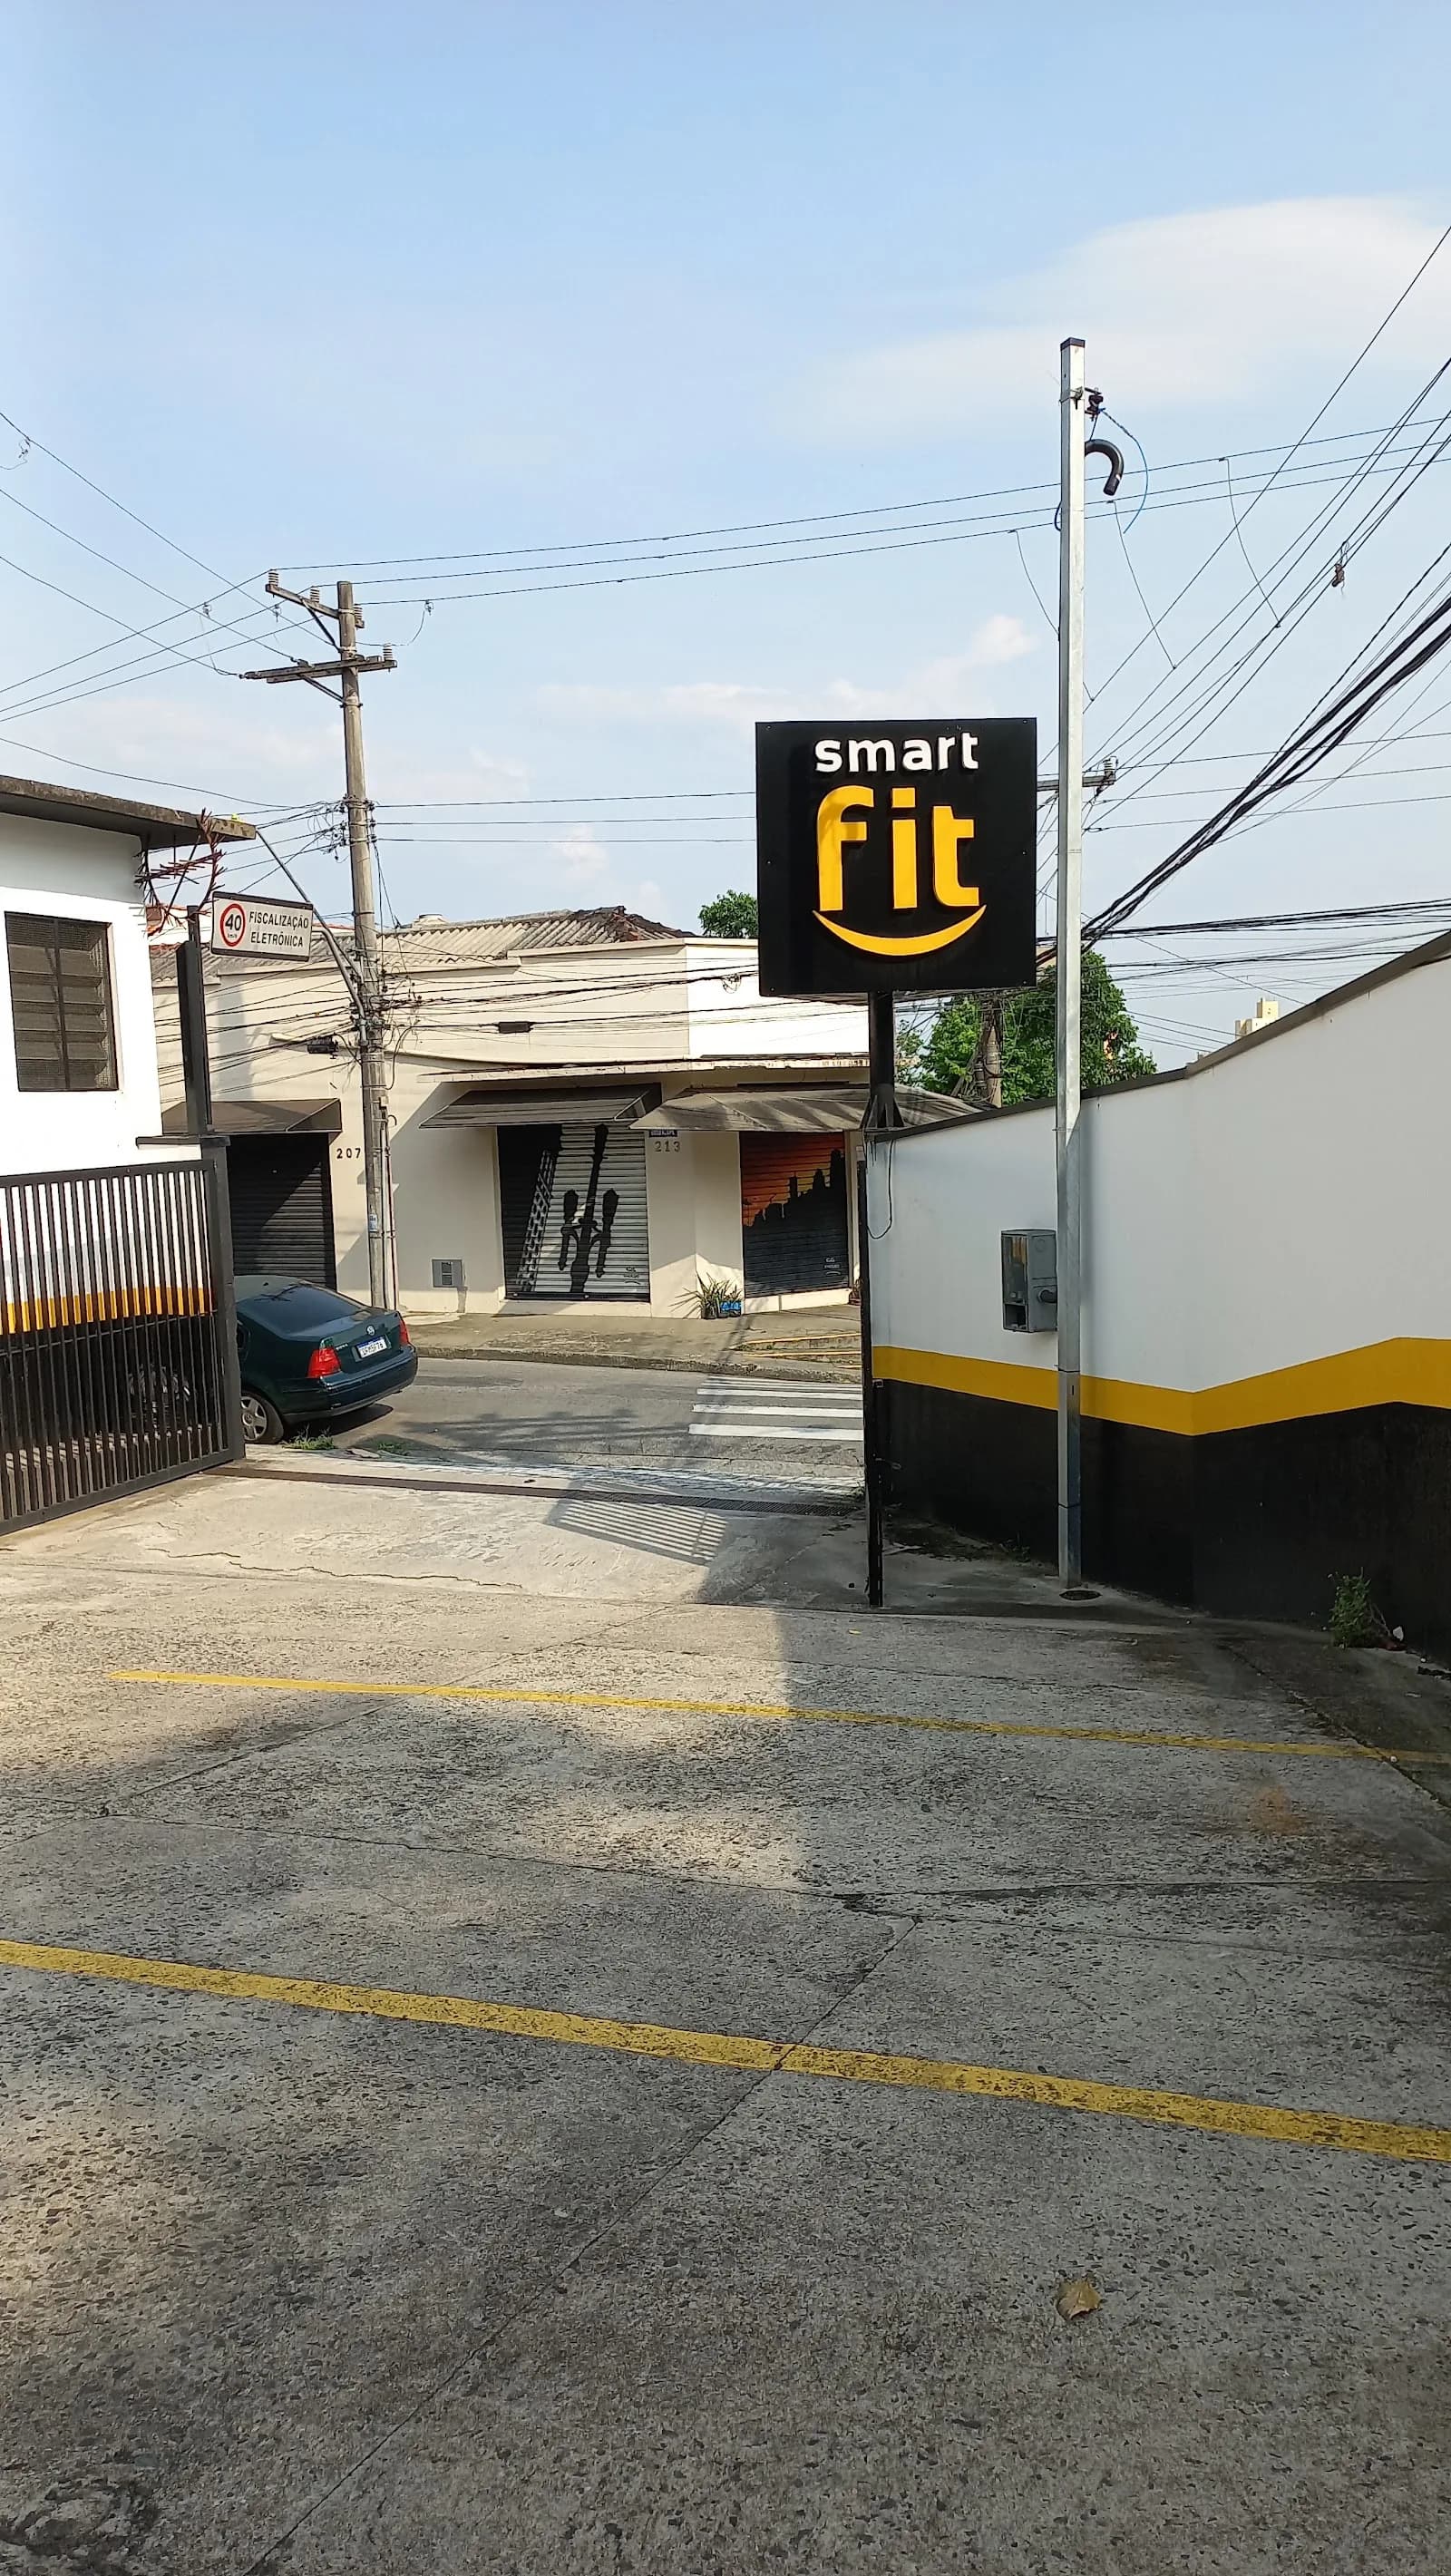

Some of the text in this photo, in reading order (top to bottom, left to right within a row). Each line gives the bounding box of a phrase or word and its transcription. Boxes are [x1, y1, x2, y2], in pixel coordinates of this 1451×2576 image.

[814, 732, 979, 772] smart
[817, 785, 979, 911] fit
[225, 913, 241, 931] 40
[248, 911, 309, 930] FISCALIZAÇÃO
[250, 931, 303, 947] ELETRÔNICA
[336, 1148, 361, 1159] 207
[654, 1141, 680, 1152] 213
